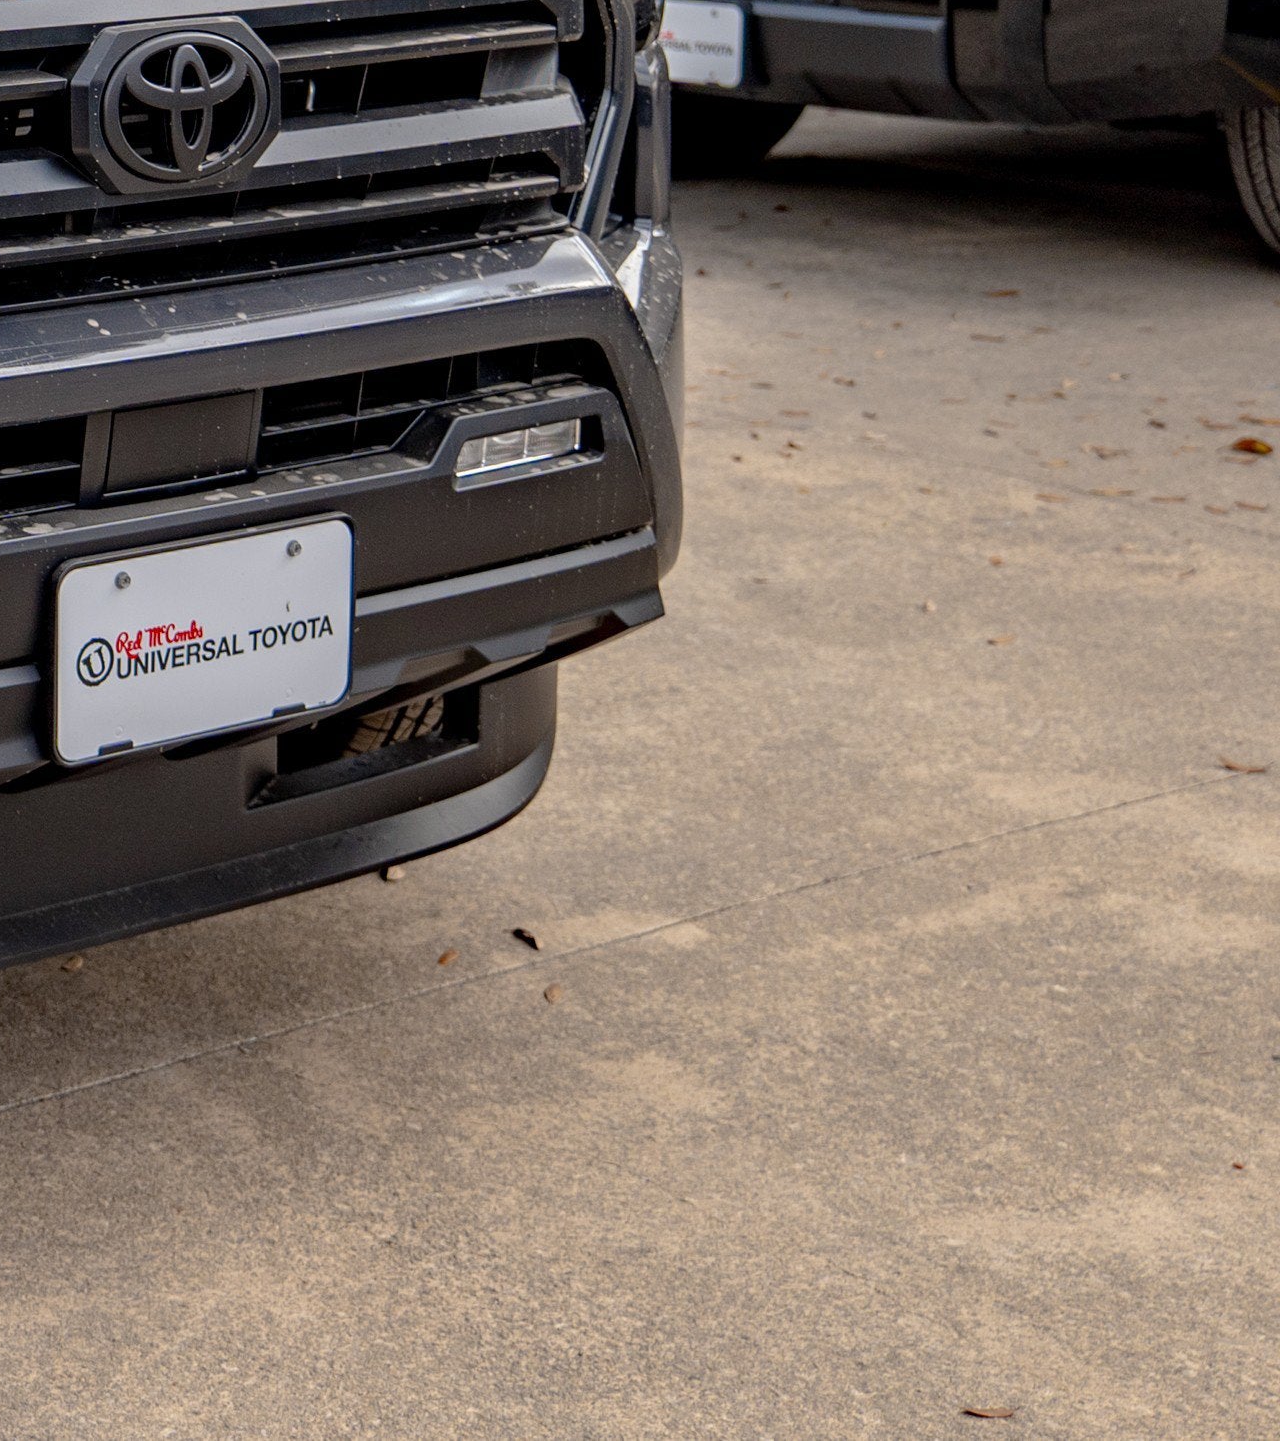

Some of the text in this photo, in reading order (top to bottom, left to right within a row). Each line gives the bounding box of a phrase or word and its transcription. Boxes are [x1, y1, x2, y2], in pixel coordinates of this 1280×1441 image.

[115, 619, 203, 659] Red McCombs
[116, 615, 333, 679] UNIVERSAL TOYOTA
